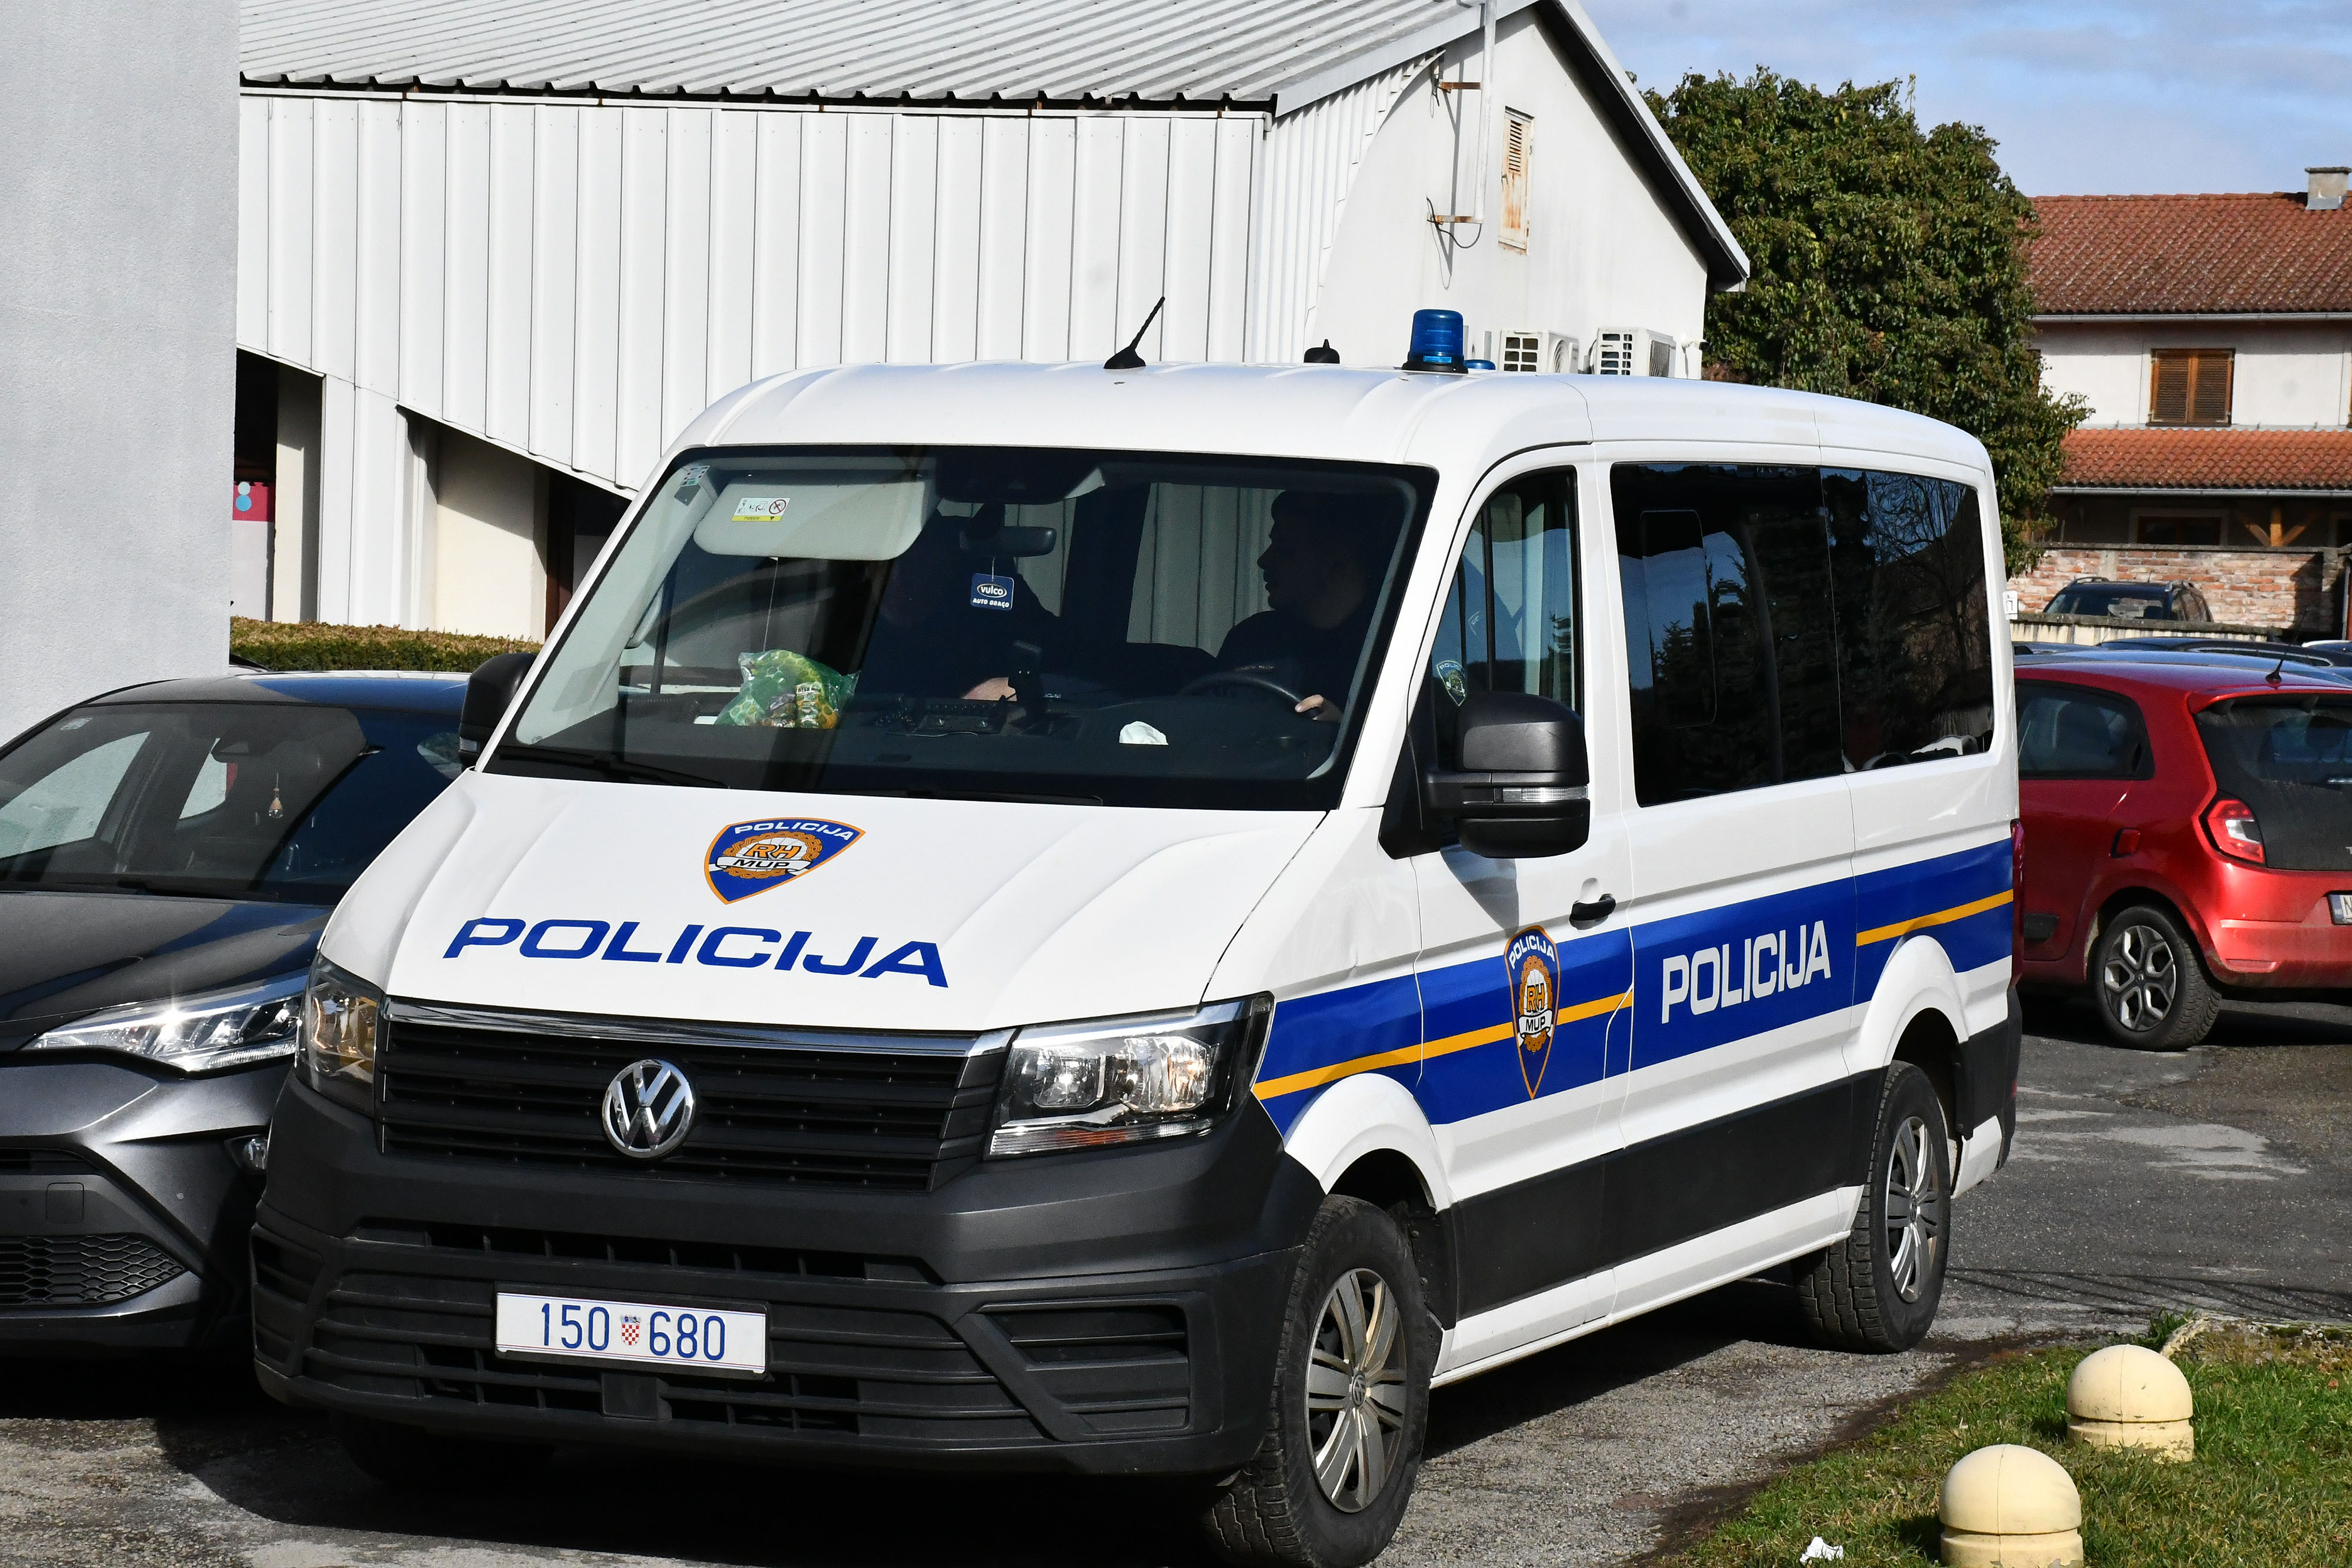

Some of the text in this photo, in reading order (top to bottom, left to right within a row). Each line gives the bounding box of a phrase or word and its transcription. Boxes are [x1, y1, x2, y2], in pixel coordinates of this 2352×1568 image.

[980, 585, 1004, 596] vulco
[734, 822, 854, 841] POLICIJA
[744, 843, 802, 860] RH
[735, 859, 790, 869] MUP
[443, 917, 948, 988] POLICIJA
[1508, 935, 1556, 970] POLICIJA
[1662, 920, 1831, 1024] POLICIJA
[1526, 983, 1545, 1013] RH
[1526, 1015, 1546, 1032] MUP
[542, 1303, 726, 1361] 150 680
